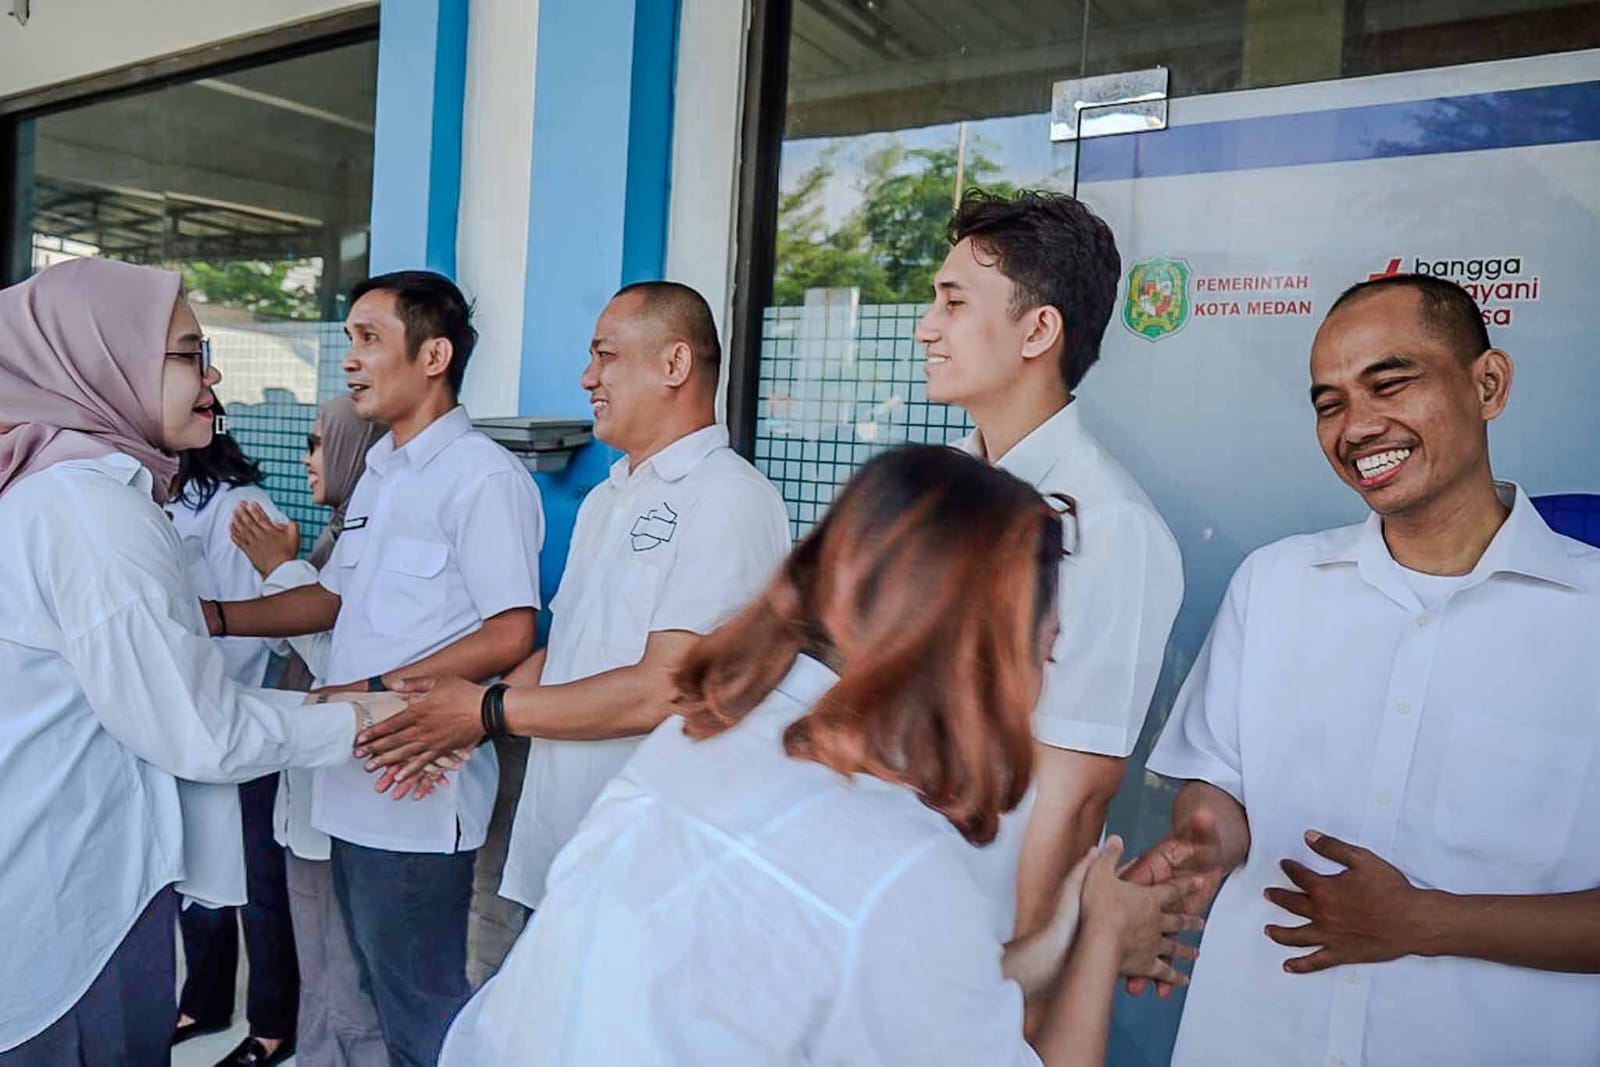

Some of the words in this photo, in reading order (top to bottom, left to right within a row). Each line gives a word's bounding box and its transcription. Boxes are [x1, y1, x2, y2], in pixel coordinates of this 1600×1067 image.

[1415, 258, 1520, 280] bangga
[1196, 275, 1308, 291] PEMERINTAH
[1194, 302, 1240, 316] KOTA
[1247, 300, 1312, 315] MEDAN
